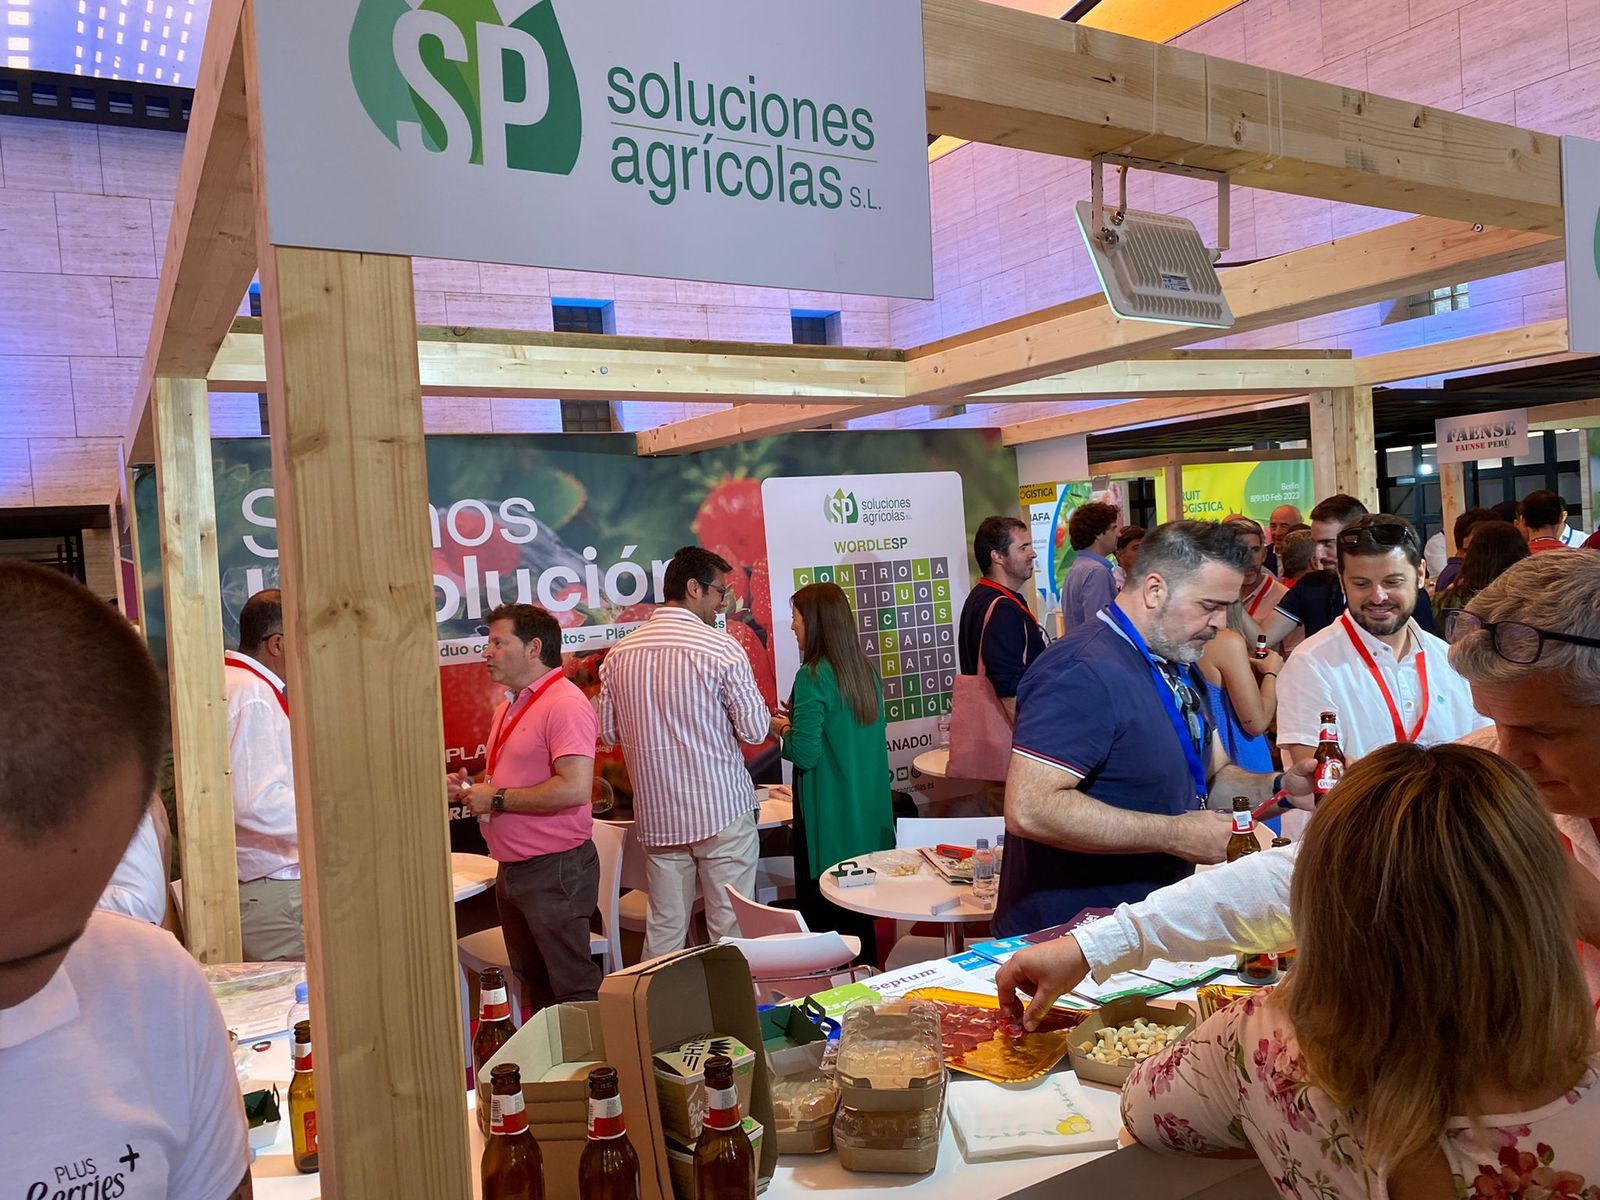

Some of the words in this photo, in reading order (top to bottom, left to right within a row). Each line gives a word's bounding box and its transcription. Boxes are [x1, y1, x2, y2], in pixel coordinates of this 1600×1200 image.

[392, 8, 549, 175] SP
[606, 60, 875, 152] soluciones
[609, 132, 843, 210] agrícolas
[849, 186, 882, 210] S.L.
[1446, 420, 1517, 443] FAENSE
[1455, 441, 1486, 452] FAENSE
[1487, 437, 1510, 449] PERÚ
[829, 497, 854, 524] SP
[861, 497, 911, 511] soluciones
[862, 510, 906, 526] agrícolas
[833, 536, 908, 554] WORDLESP
[440, 642, 469, 657] duo
[886, 733, 933, 752] ANADO!
[868, 968, 936, 992] Septum
[54, 1158, 97, 1184] PLUS
